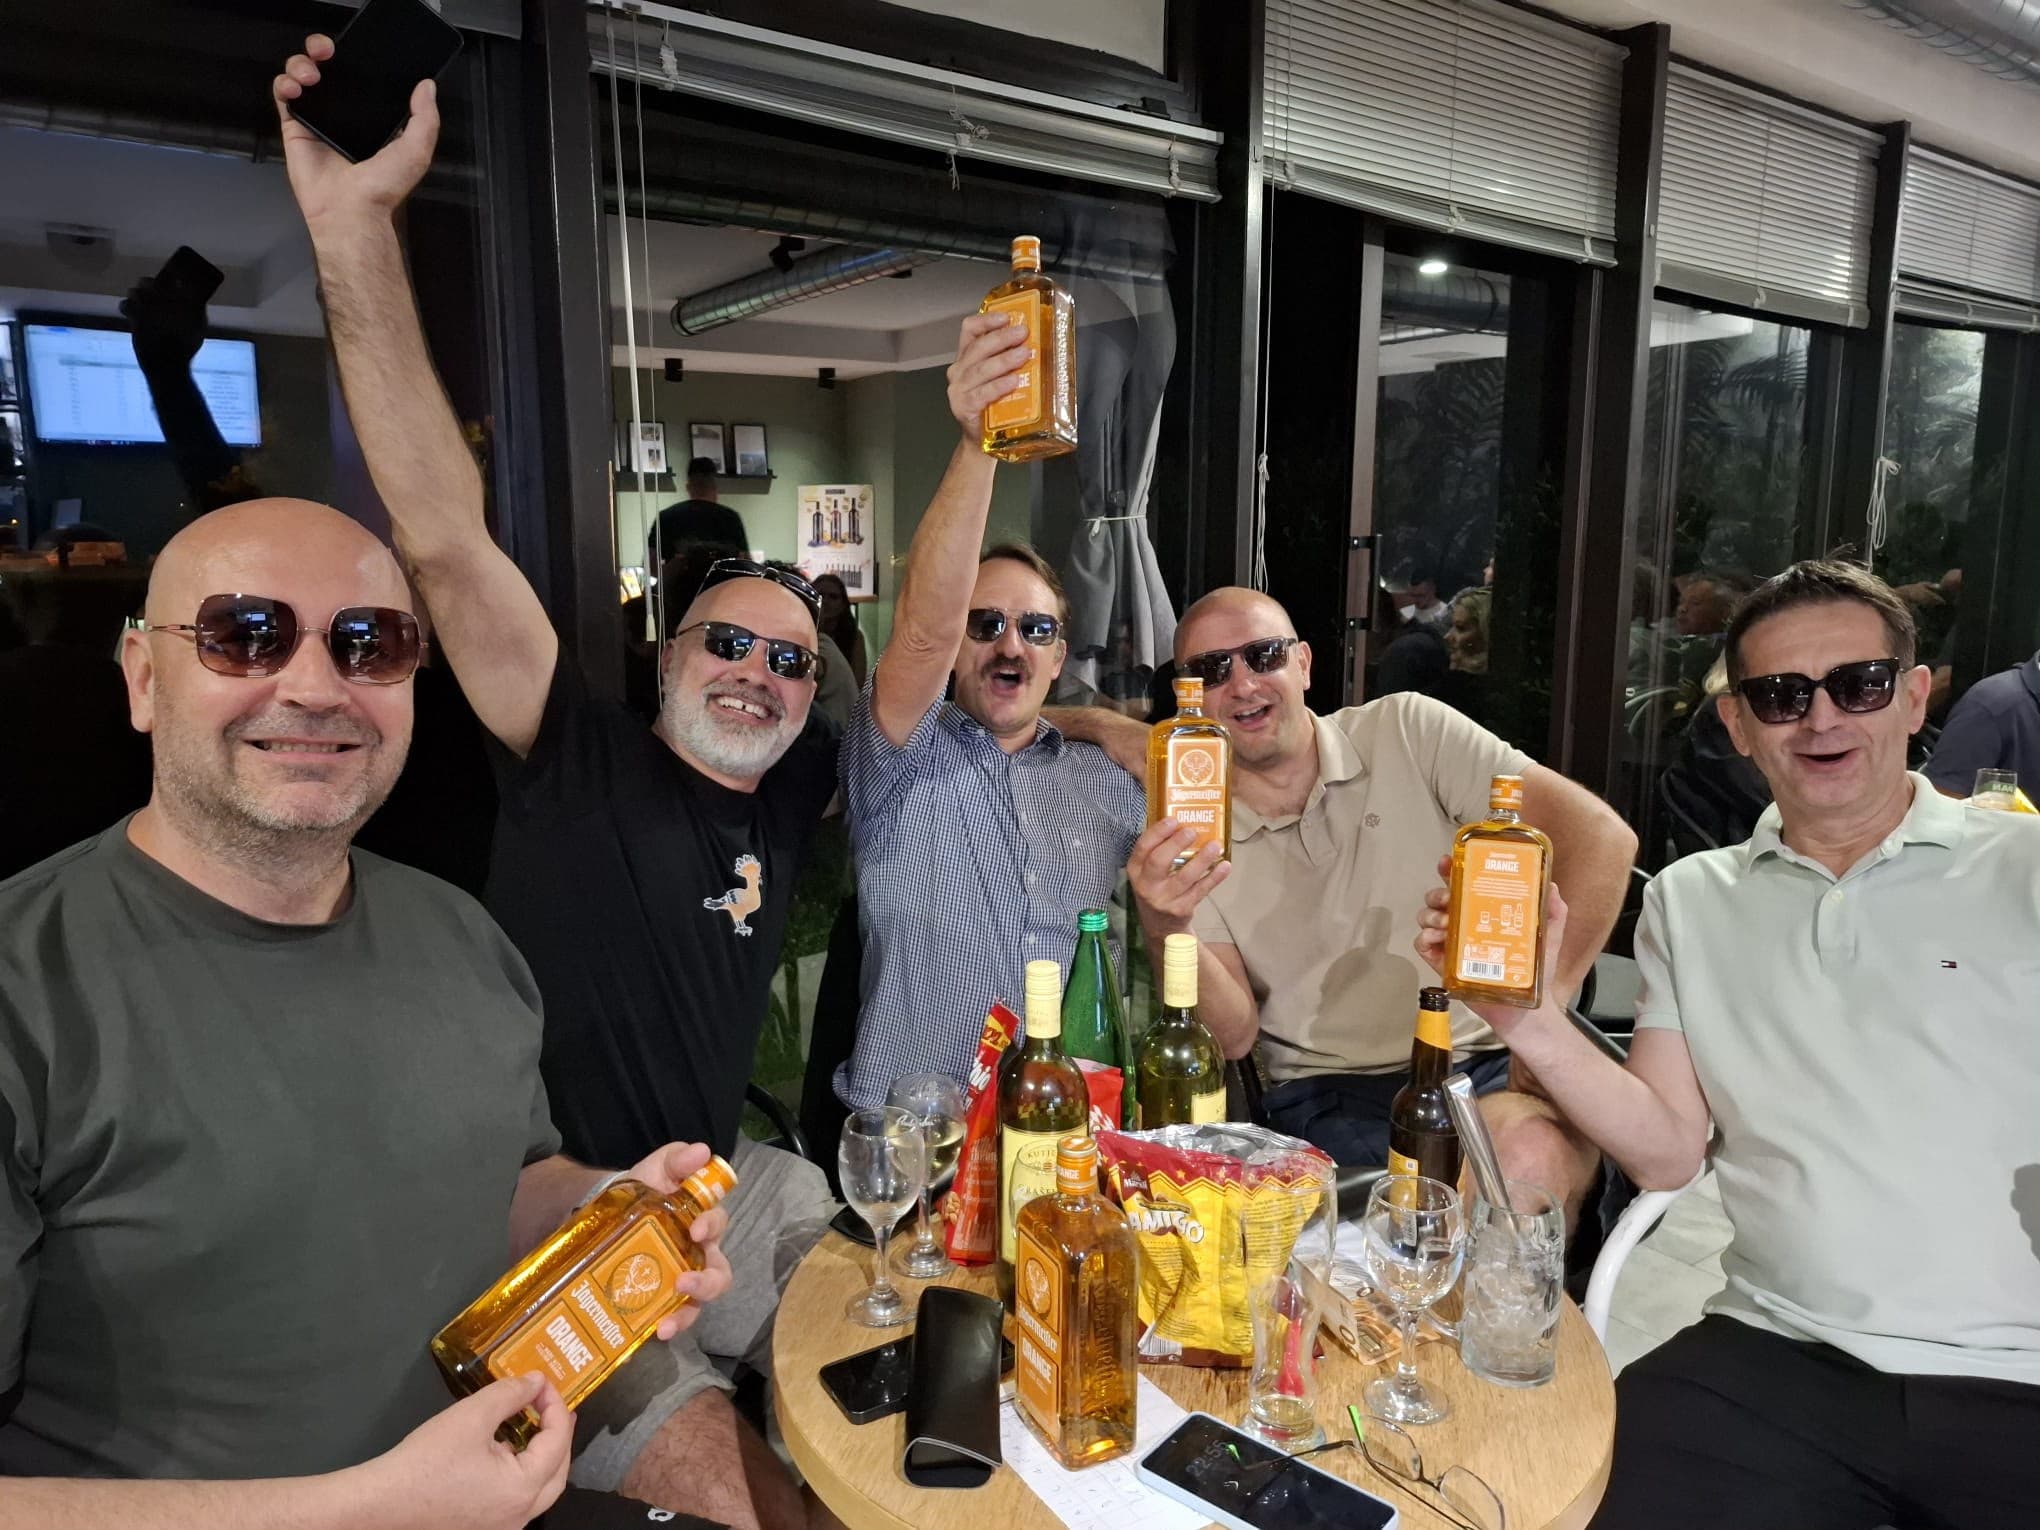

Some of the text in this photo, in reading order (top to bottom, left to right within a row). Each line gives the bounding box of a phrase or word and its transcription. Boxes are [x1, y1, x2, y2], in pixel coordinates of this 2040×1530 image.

[1177, 809, 1215, 823] ORANGE
[1484, 858, 1520, 873] ORANGE
[1128, 1210, 1204, 1244] AMIGO
[545, 1314, 594, 1373] ORANGE
[1022, 1336, 1053, 1385] ORANGE
